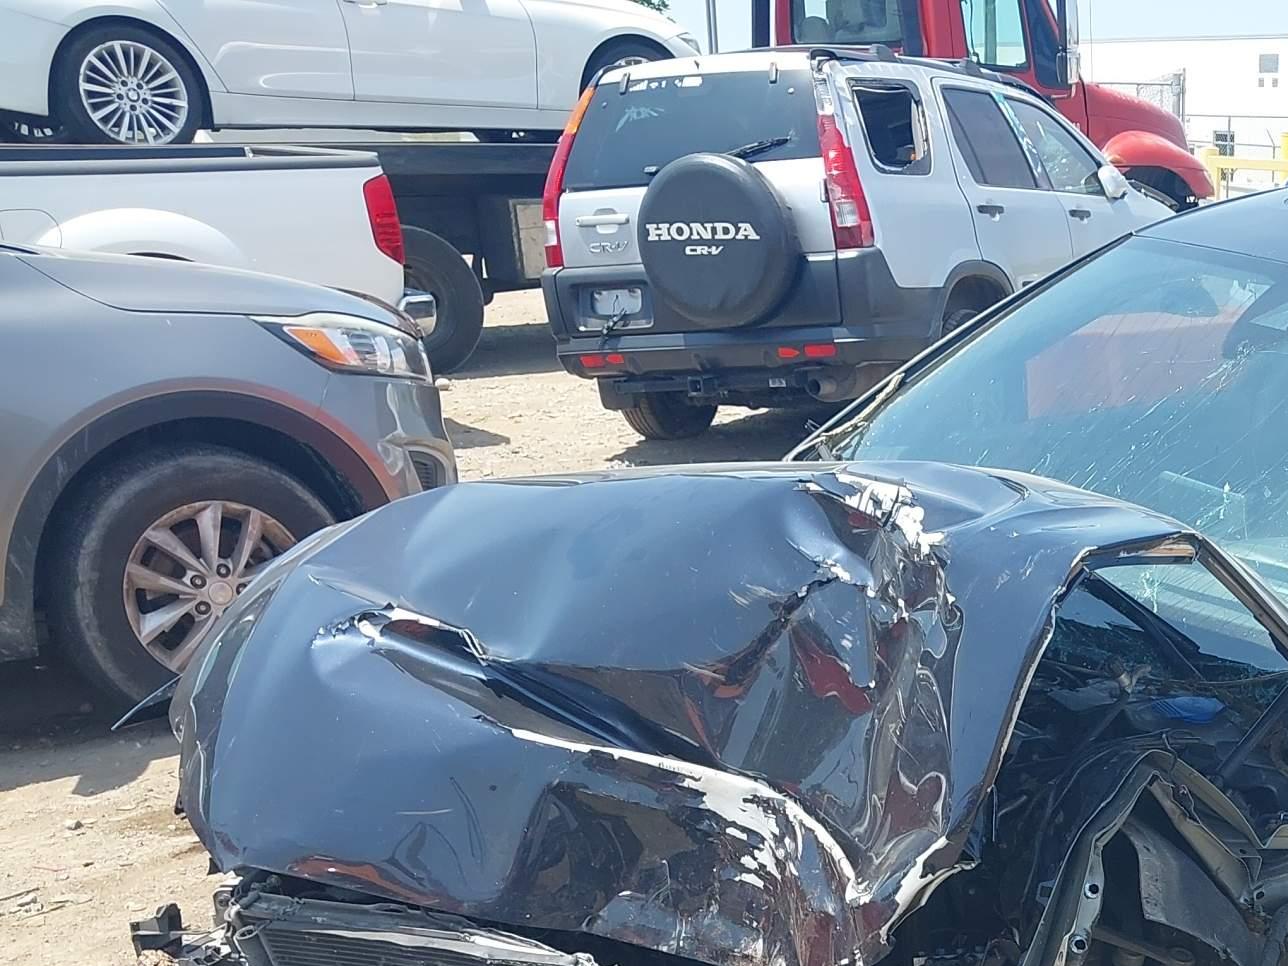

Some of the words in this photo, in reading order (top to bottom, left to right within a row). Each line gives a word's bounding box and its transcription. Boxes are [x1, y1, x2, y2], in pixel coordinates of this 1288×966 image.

[645, 222, 761, 242] HONDA
[590, 240, 630, 254] CR-V
[684, 245, 724, 256] CR-V
